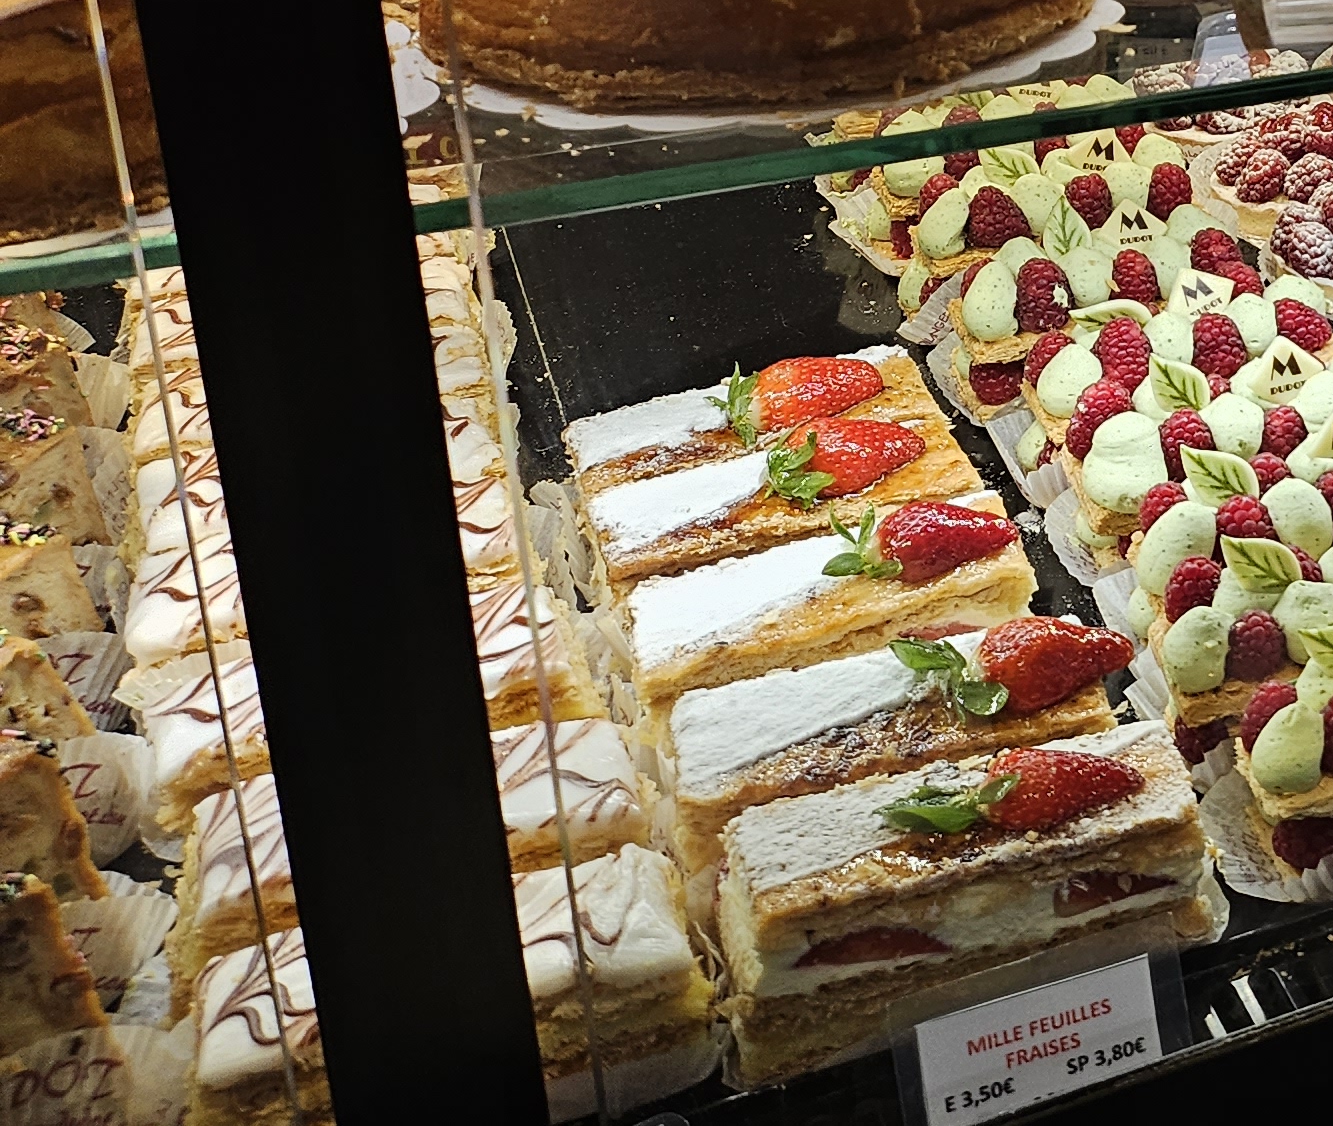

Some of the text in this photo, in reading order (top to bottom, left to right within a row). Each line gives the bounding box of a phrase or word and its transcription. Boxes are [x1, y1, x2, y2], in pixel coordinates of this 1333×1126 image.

[1086, 137, 1116, 162] M
[1119, 209, 1149, 233] M
[1119, 234, 1154, 246] DUDOT
[1181, 275, 1215, 308] M
[1270, 351, 1303, 382] M
[965, 998, 1112, 1056] MILLE FEUILLES
[1004, 1031, 1082, 1070] FRAISES
[1066, 1035, 1147, 1076] SP 3,80€
[944, 1076, 1016, 1114] E 3,50€
